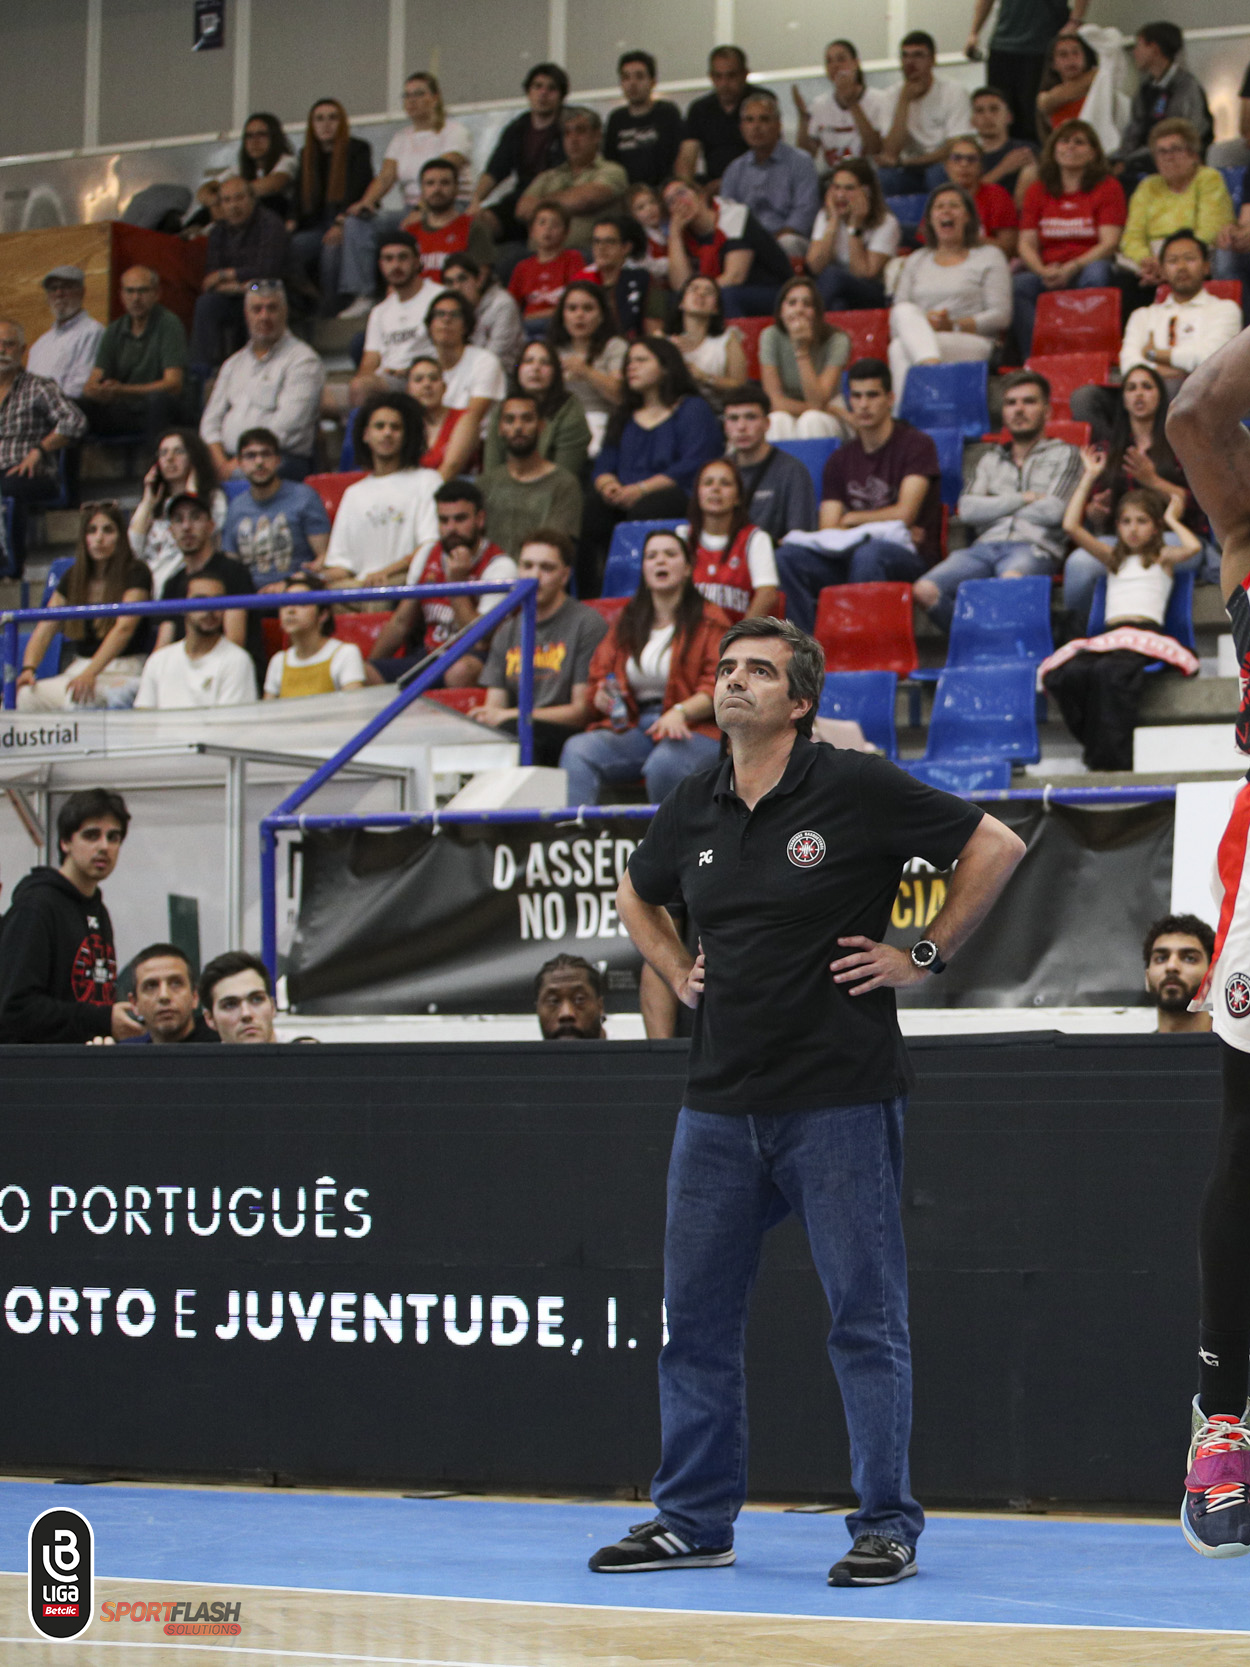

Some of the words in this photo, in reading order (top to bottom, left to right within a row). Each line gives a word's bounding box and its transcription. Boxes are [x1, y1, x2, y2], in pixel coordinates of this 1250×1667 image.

[0, 722, 79, 748] dustrial
[493, 844, 517, 891] O
[526, 831, 641, 888] ASSÉD
[518, 891, 567, 940] NO
[50, 1175, 372, 1238] PORTUGUÊS
[4, 1285, 157, 1338] ORTO
[175, 1289, 197, 1339] E
[215, 1290, 584, 1356] JUVENTUDE,
